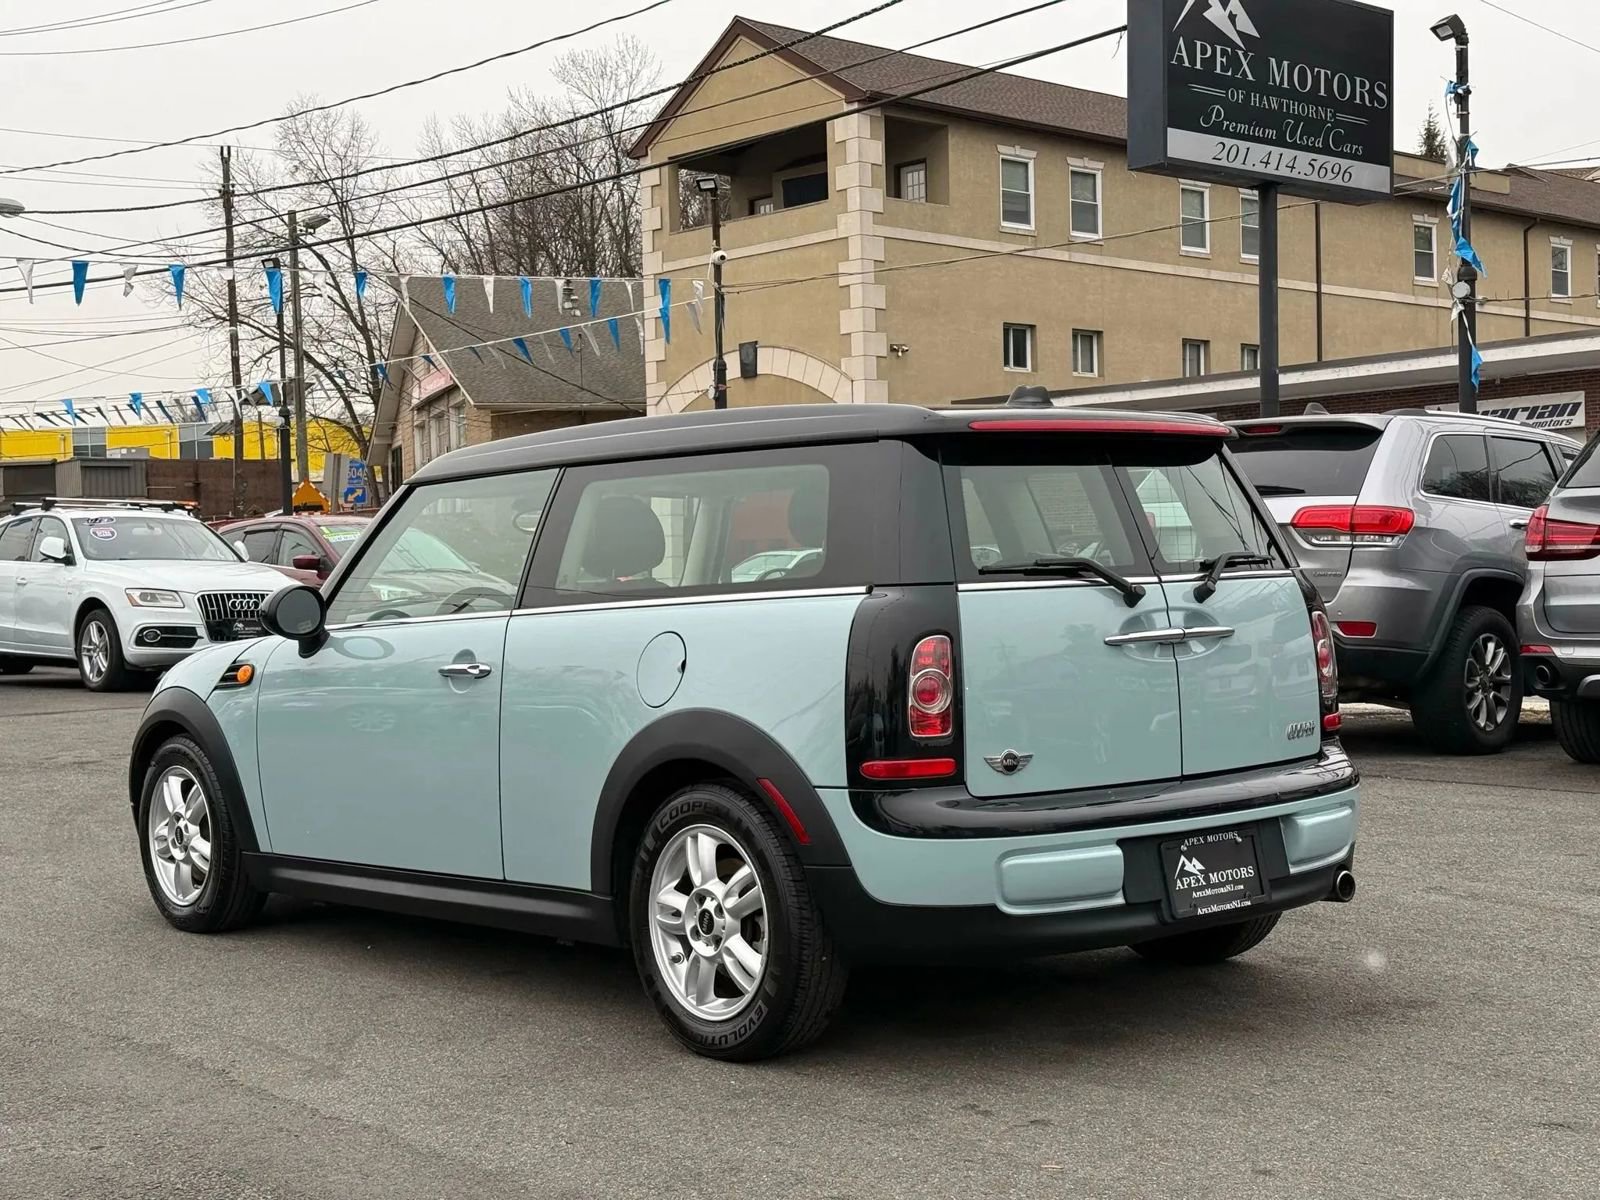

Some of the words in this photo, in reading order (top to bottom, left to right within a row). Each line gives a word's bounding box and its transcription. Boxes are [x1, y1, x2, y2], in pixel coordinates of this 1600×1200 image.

[1170, 36, 1256, 81] APEX
[1267, 56, 1388, 109] MOTORS
[1228, 87, 1246, 104] OF
[1250, 92, 1335, 122] HAWTHORNE
[1200, 104, 1277, 140] Premium
[1282, 119, 1331, 149] Used
[1329, 128, 1364, 156] Cars
[1211, 141, 1355, 184] 201.414.5696
[1531, 418, 1574, 428] motors
[1184, 836, 1205, 846] APEX
[1207, 831, 1238, 843] MOTORS
[1176, 875, 1206, 890] APEX
[1209, 866, 1254, 884] MOTORS
